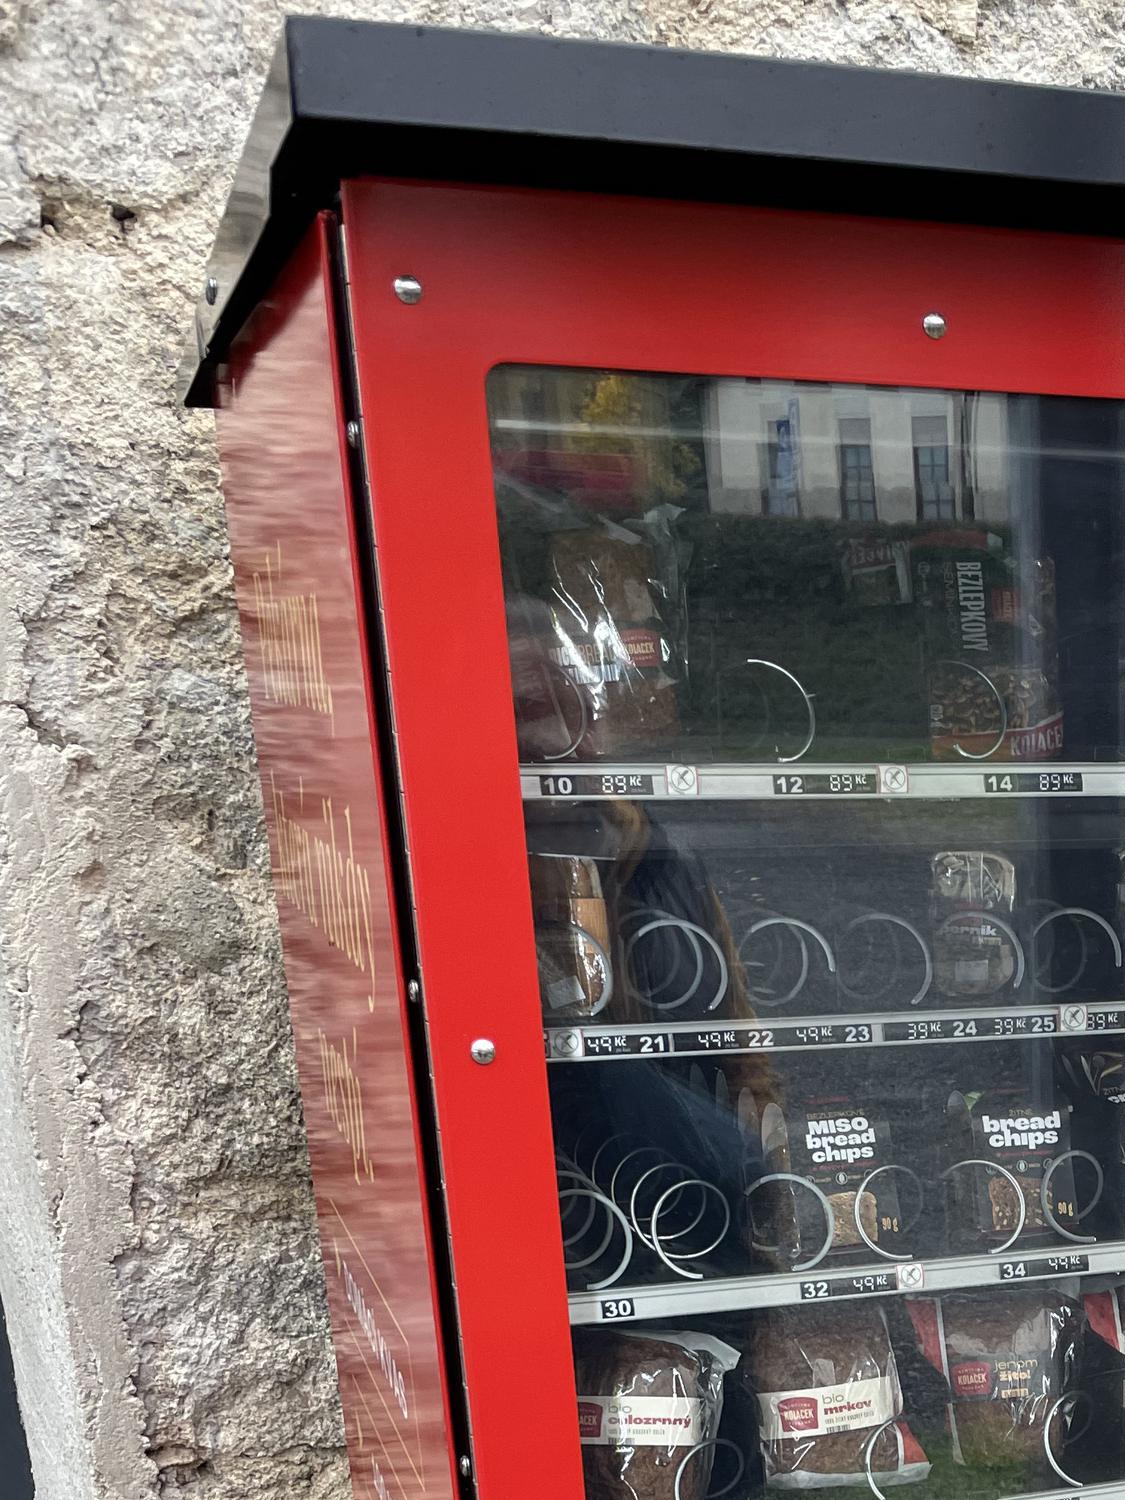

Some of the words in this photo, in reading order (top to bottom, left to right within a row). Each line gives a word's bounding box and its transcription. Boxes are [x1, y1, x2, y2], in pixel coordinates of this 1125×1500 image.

[544, 776, 573, 794] 10
[602, 775, 626, 793] 89
[776, 776, 803, 794] 12
[830, 775, 852, 792] 89
[987, 775, 1012, 792] 14
[1039, 774, 1061, 790] 89
[587, 1036, 612, 1052] 49
[615, 1035, 627, 1047] Kč
[639, 1036, 665, 1052] 21
[698, 1032, 721, 1048] 49
[723, 1031, 735, 1042] Kč
[748, 1031, 774, 1047] 22
[796, 1027, 819, 1043] 49
[821, 1025, 833, 1037] Kč
[845, 1026, 870, 1042] 23
[908, 1023, 928, 1040] 39
[952, 1020, 977, 1037] 24
[994, 1018, 1013, 1035] 39
[1031, 1017, 1055, 1033] 25
[807, 1116, 869, 1135] MISO
[982, 1111, 1061, 1133] bread
[805, 1128, 876, 1149] bread
[989, 1129, 1059, 1150] chips
[812, 1146, 874, 1163] chips
[1003, 1262, 1026, 1279] 34
[1048, 1255, 1069, 1271] 49
[804, 1281, 829, 1298] 32
[853, 1276, 874, 1291] 49
[605, 1301, 632, 1317] 30
[993, 1358, 1038, 1373] jenom
[821, 1393, 845, 1405] bio
[823, 1399, 873, 1416] mrkev
